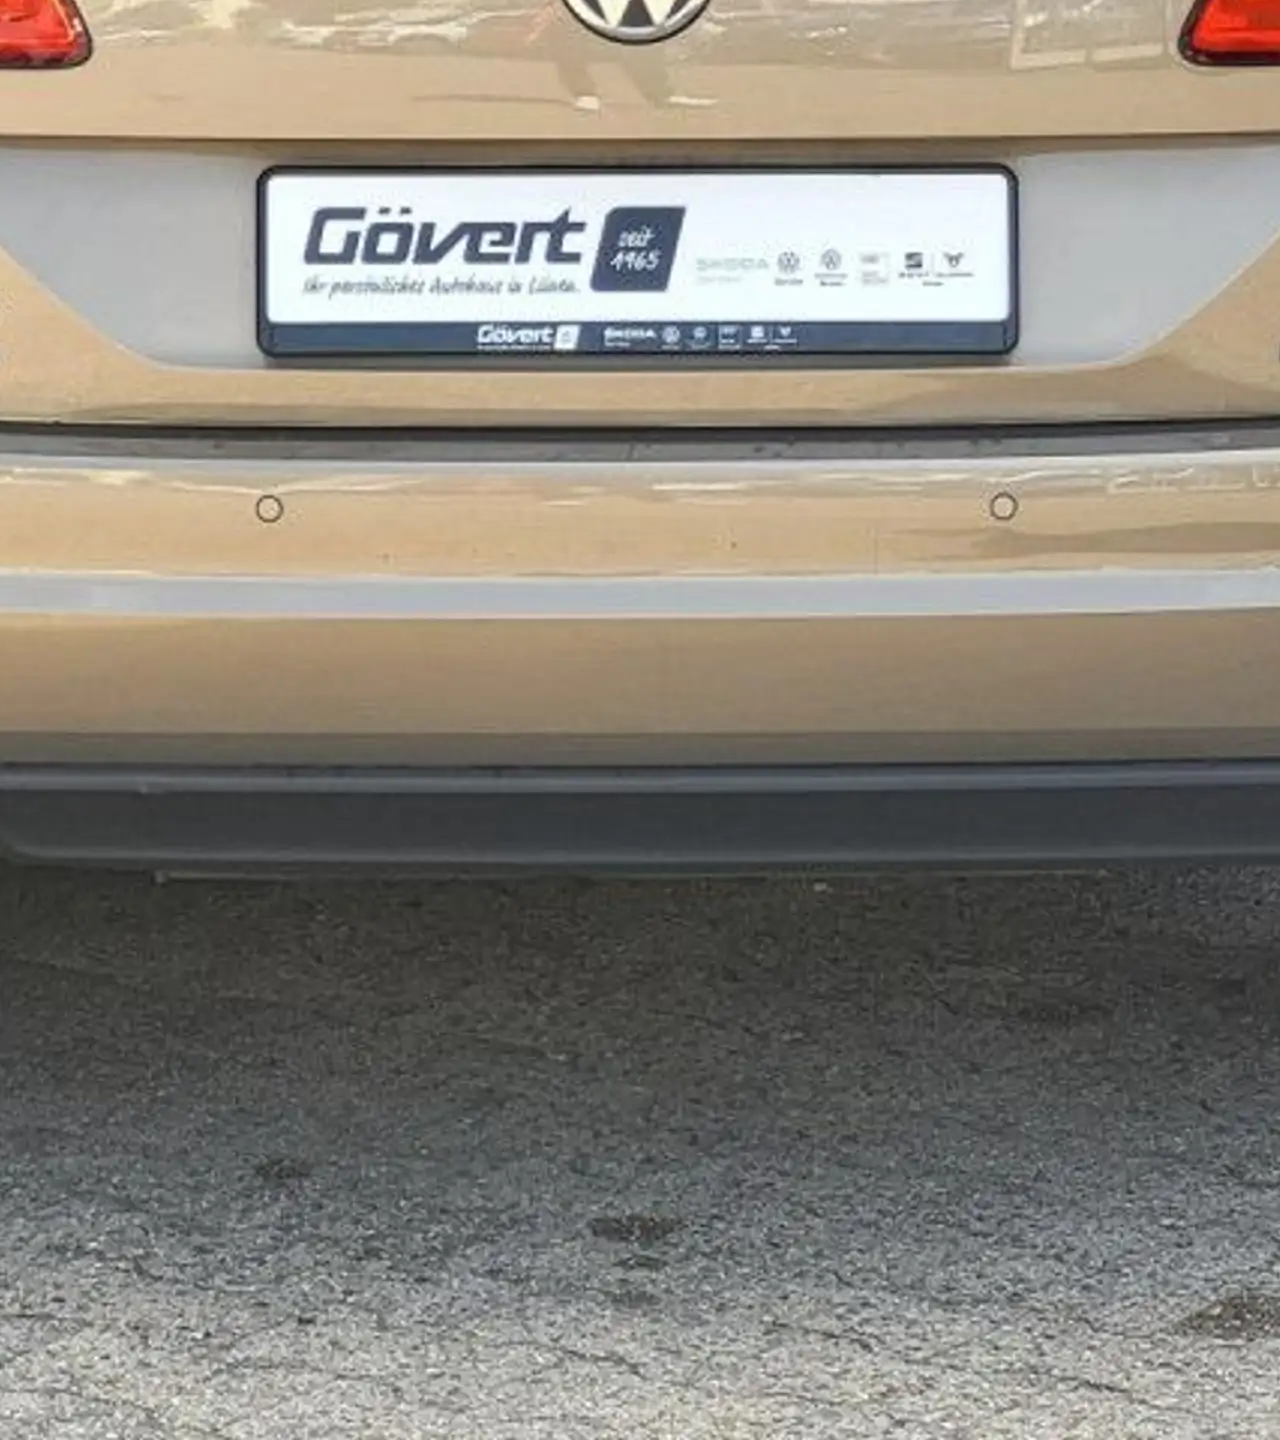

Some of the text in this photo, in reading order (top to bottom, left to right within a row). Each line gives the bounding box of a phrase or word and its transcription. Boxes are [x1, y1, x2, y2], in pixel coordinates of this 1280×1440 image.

[302, 205, 588, 265] Gövert
[617, 224, 655, 247] seit
[609, 250, 661, 273] 1965
